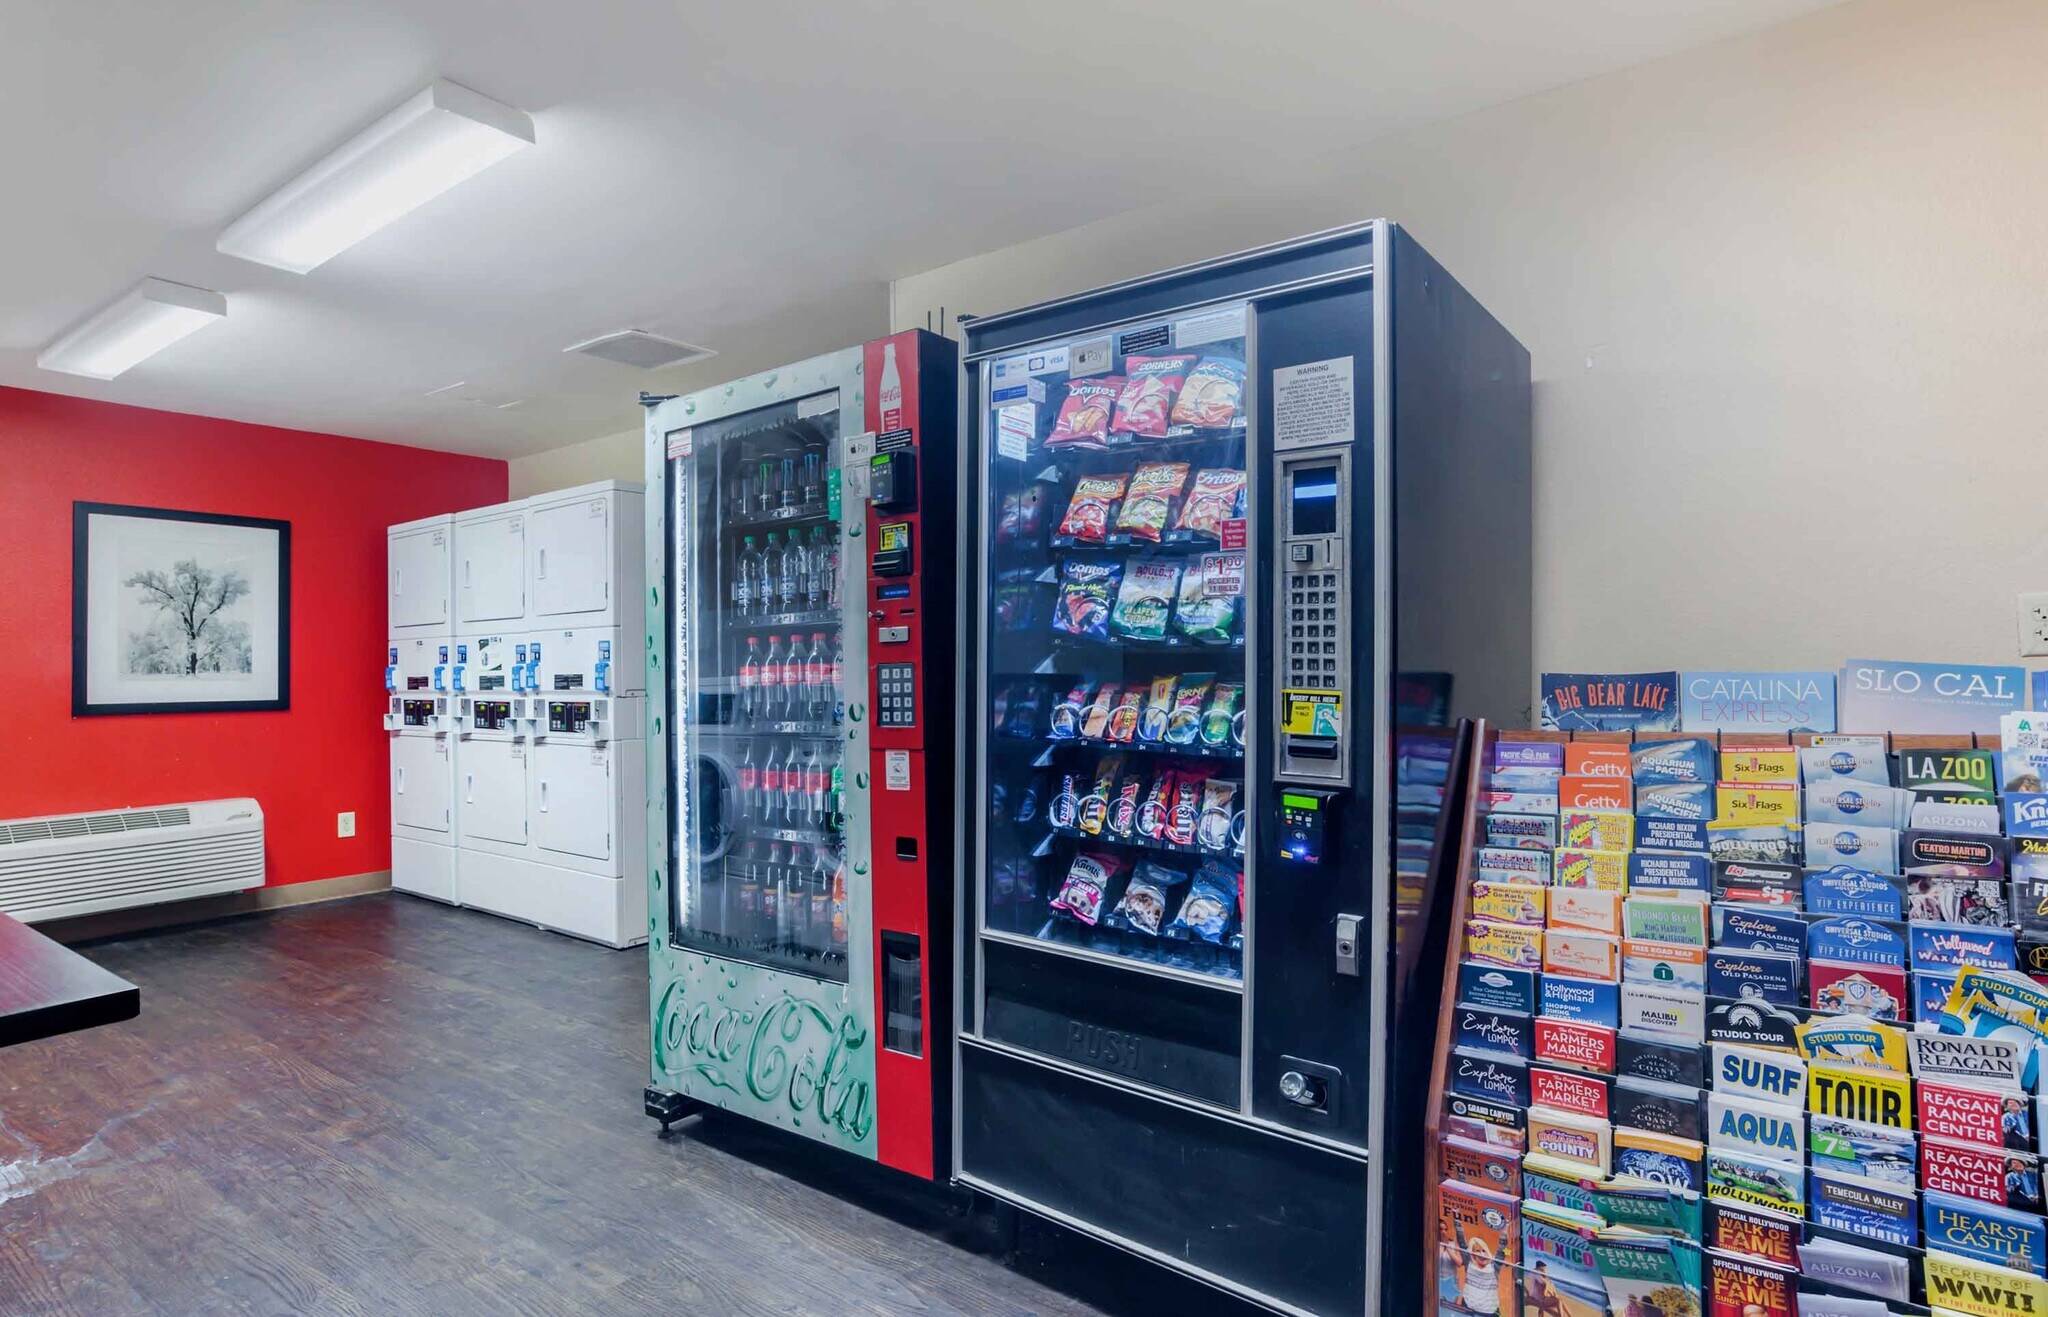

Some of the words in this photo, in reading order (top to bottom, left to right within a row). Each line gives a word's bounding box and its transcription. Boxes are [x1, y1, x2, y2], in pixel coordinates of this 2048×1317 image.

[1087, 349, 1103, 362] Pay
[1139, 359, 1184, 371] CORNERS
[1297, 365, 1329, 377] WARNING
[1070, 385, 1117, 397] Doritos
[1068, 562, 1110, 577] Doritos
[1207, 577, 1240, 585] ACCEPTS
[1689, 678, 1823, 701] CATALINA
[1856, 668, 1921, 693] SLO
[1934, 672, 2014, 699] CAL
[1555, 685, 1582, 710] BIG
[1587, 683, 1625, 707] BEAR
[1634, 684, 1669, 711] LAKE
[1700, 701, 1810, 722] EXPRESS
[1640, 756, 1695, 769] AQUARIUM
[1659, 763, 1695, 777] PACIFIC
[1734, 764, 1750, 772] Six
[1758, 764, 1784, 773] Flags
[1907, 757, 1937, 779] LA
[1941, 757, 1986, 780] ZOO
[1648, 792, 1702, 812] AQUARIUM
[1661, 803, 1701, 819] PACIFIC
[1731, 800, 1747, 809] Six
[1756, 801, 1783, 811] Flags
[1648, 821, 1676, 831] RICHARD
[1679, 823, 1697, 832] NIXON
[1650, 830, 1693, 840] PRESIDENTIAL
[1641, 837, 1668, 846] LIBRARY
[1675, 839, 1704, 849] MUSEUM
[1919, 843, 1950, 855] TEATRO
[1951, 845, 1987, 858] MARTINI
[1640, 859, 1669, 869] RICHARD
[1672, 861, 1690, 870] NIXON
[1644, 868, 1688, 878] PRESIDENTIAL
[1635, 876, 1661, 886] LIBRARY
[1668, 877, 1698, 886] MUSEUM
[1822, 879, 1858, 889] UNIVERSAL
[1859, 881, 1888, 891] STUDIOS
[1816, 899, 1832, 909] VIP
[1837, 900, 1895, 914] EXPERIENCE
[1644, 923, 1659, 932] KING
[1660, 925, 1687, 935] HARBOR
[1729, 915, 1777, 932] Explore
[1735, 927, 1755, 936] OLD
[1756, 930, 1799, 944] PASADENA
[1825, 926, 1862, 937] UNIVERSAL
[1862, 929, 1893, 942] STUDIOS
[1818, 945, 1834, 956] VIP
[1838, 948, 1899, 965] EXPERIENCE
[1918, 951, 1949, 963] WAX
[1952, 956, 2009, 970] MUSEUM
[1714, 960, 1763, 973] Explore
[1721, 971, 1740, 979] OLD
[1742, 972, 1786, 982] PASADENA
[1545, 982, 1594, 996] Hollywood
[1545, 991, 1594, 1004] &Highland
[1971, 978, 2015, 995] STUDIO
[2018, 991, 2048, 1009] TOUR
[1545, 1002, 1581, 1012] SHOPPING
[1545, 1008, 1570, 1017] DINING
[1641, 1010, 1678, 1022] MALIBU
[1462, 1012, 1520, 1036] Explore
[1641, 1017, 1677, 1027] DISCOVERY
[1487, 1033, 1519, 1047] LOMPOC
[1543, 1030, 1604, 1050] FARMERS
[1711, 1029, 1751, 1039] STUDIO
[1753, 1031, 1784, 1042] TOUR
[1808, 1032, 1845, 1045] STUDIO
[1847, 1032, 1877, 1043] TOUR
[1547, 1041, 1602, 1060] MARKET
[1915, 1037, 2011, 1058] RONALD
[1458, 1059, 1517, 1084] Explore
[1638, 1064, 1675, 1077] COAST
[1918, 1053, 2013, 1072] REAGAN
[1722, 1054, 1801, 1096] SURF
[1484, 1080, 1515, 1095] LOMPOC
[1538, 1077, 1600, 1098] FARMERS
[1542, 1089, 1597, 1109] MARKET
[1815, 1077, 1902, 1128] TOUR
[1923, 1092, 1998, 1115] REAGAN
[1468, 1103, 1489, 1115] GRAND
[1489, 1108, 1515, 1121] CANYON
[1636, 1112, 1673, 1127] COAST
[1928, 1106, 1995, 1128] RANCH
[1719, 1109, 1797, 1151] AQUA
[1925, 1119, 1998, 1142] CENTER
[1539, 1141, 1595, 1159] COUNTY
[1447, 1160, 1483, 1178] Fun!
[1924, 1149, 2002, 1174] REAGAN
[1929, 1163, 1998, 1187] RANCH
[1825, 1185, 1871, 1203] TEMECULA
[1872, 1196, 1903, 1211] VALLEY
[1927, 1177, 2002, 1201] CENTER
[1599, 1197, 1665, 1211] CENTRAL
[1612, 1205, 1660, 1217] COAST
[1443, 1206, 1479, 1225] Fun!
[1719, 1208, 1747, 1221] OFFICIAL
[1748, 1213, 1790, 1232] HOLLYWOOD
[1860, 1215, 1901, 1232] California
[1718, 1216, 1764, 1236] WALK
[1767, 1228, 1791, 1242] OF
[1820, 1216, 1850, 1231] WINE
[1854, 1222, 1909, 1246] COUNTRY
[1938, 1209, 2035, 1243] HEARST
[1527, 1235, 1595, 1267] MEXICO
[1718, 1226, 1792, 1259] FAME
[1946, 1227, 2032, 1260] CASTLE
[1596, 1248, 1666, 1264] CENTRAL
[1609, 1257, 1658, 1271] COAST
[1712, 1265, 1759, 1288] WALK
[1762, 1276, 1786, 1291] OF
[1713, 1259, 1742, 1272] OFFICIAL
[1743, 1262, 1784, 1281] HOLLYWOOD
[1810, 1263, 1882, 1282] ARIZONA
[1929, 1262, 2002, 1286] SECRETS
[2009, 1276, 2032, 1290] OF
[1712, 1279, 1787, 1311] FAME
[1931, 1274, 2035, 1313] WWII
